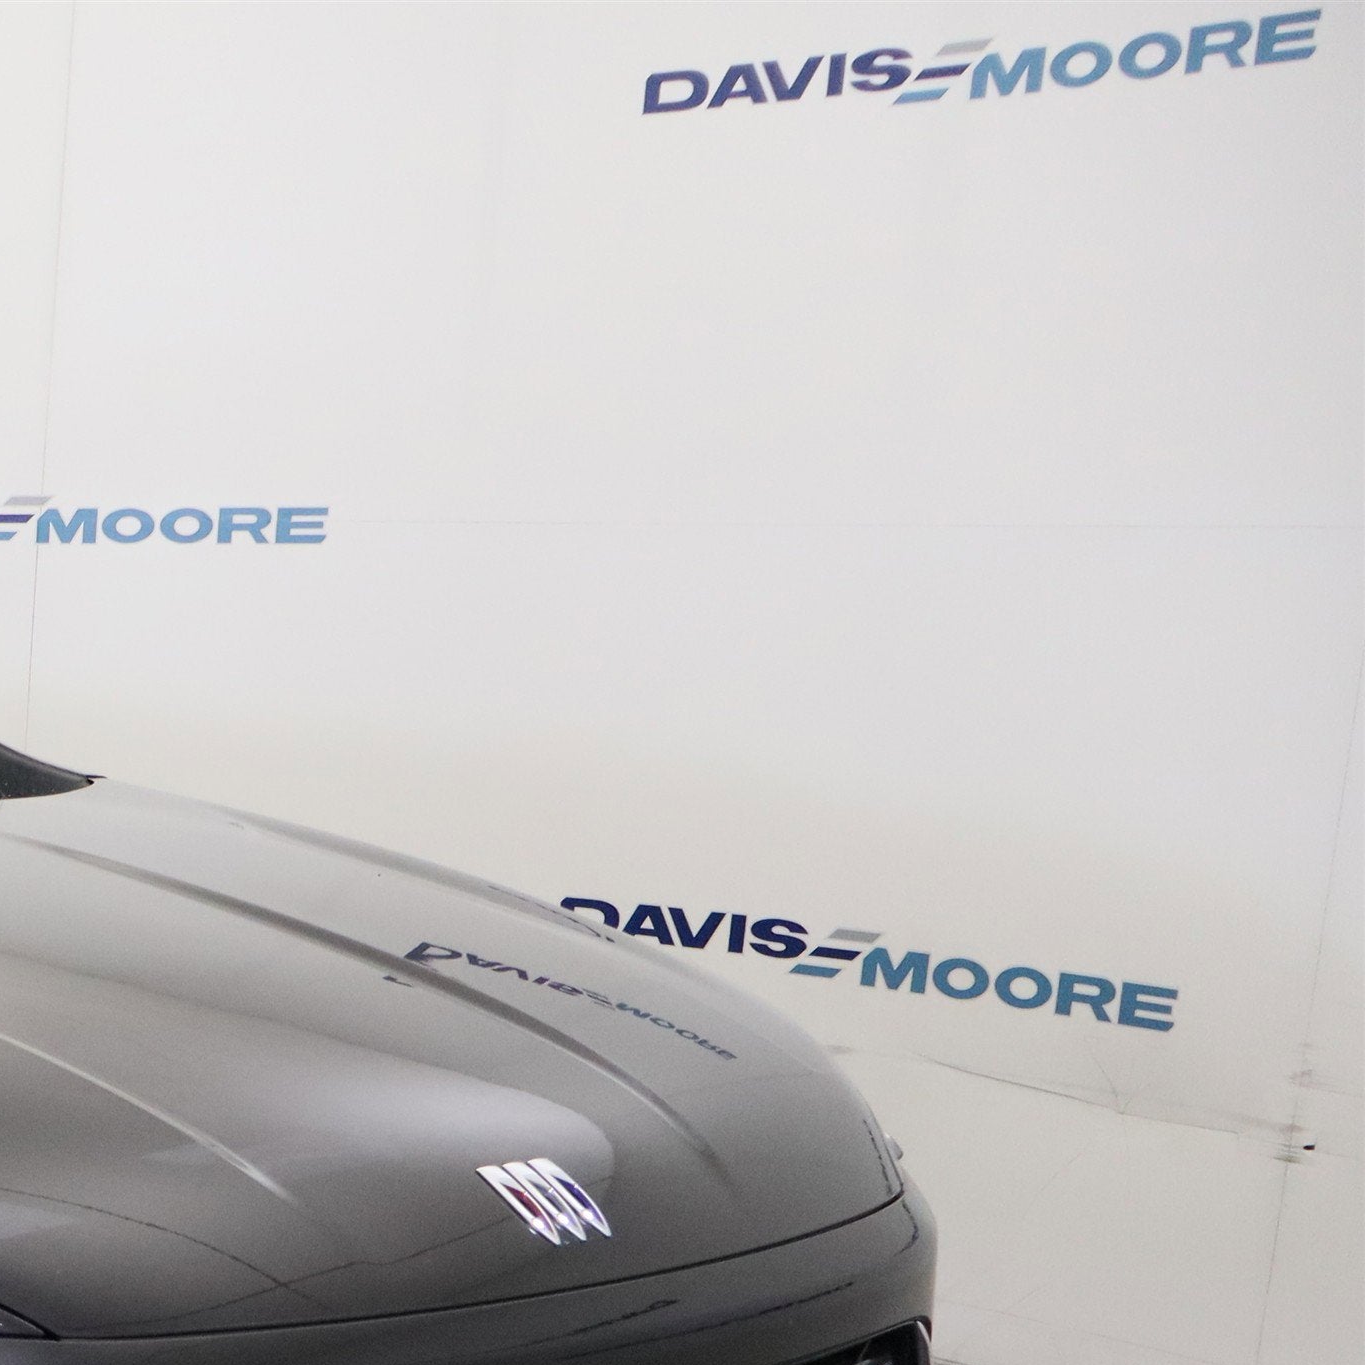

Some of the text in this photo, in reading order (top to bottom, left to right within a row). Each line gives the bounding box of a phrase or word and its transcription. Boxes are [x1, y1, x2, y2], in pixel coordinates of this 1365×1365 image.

[642, 8, 1323, 115] DAVIS MOORE
[35, 508, 330, 544] MOORE
[859, 947, 1180, 1033] MOORE
